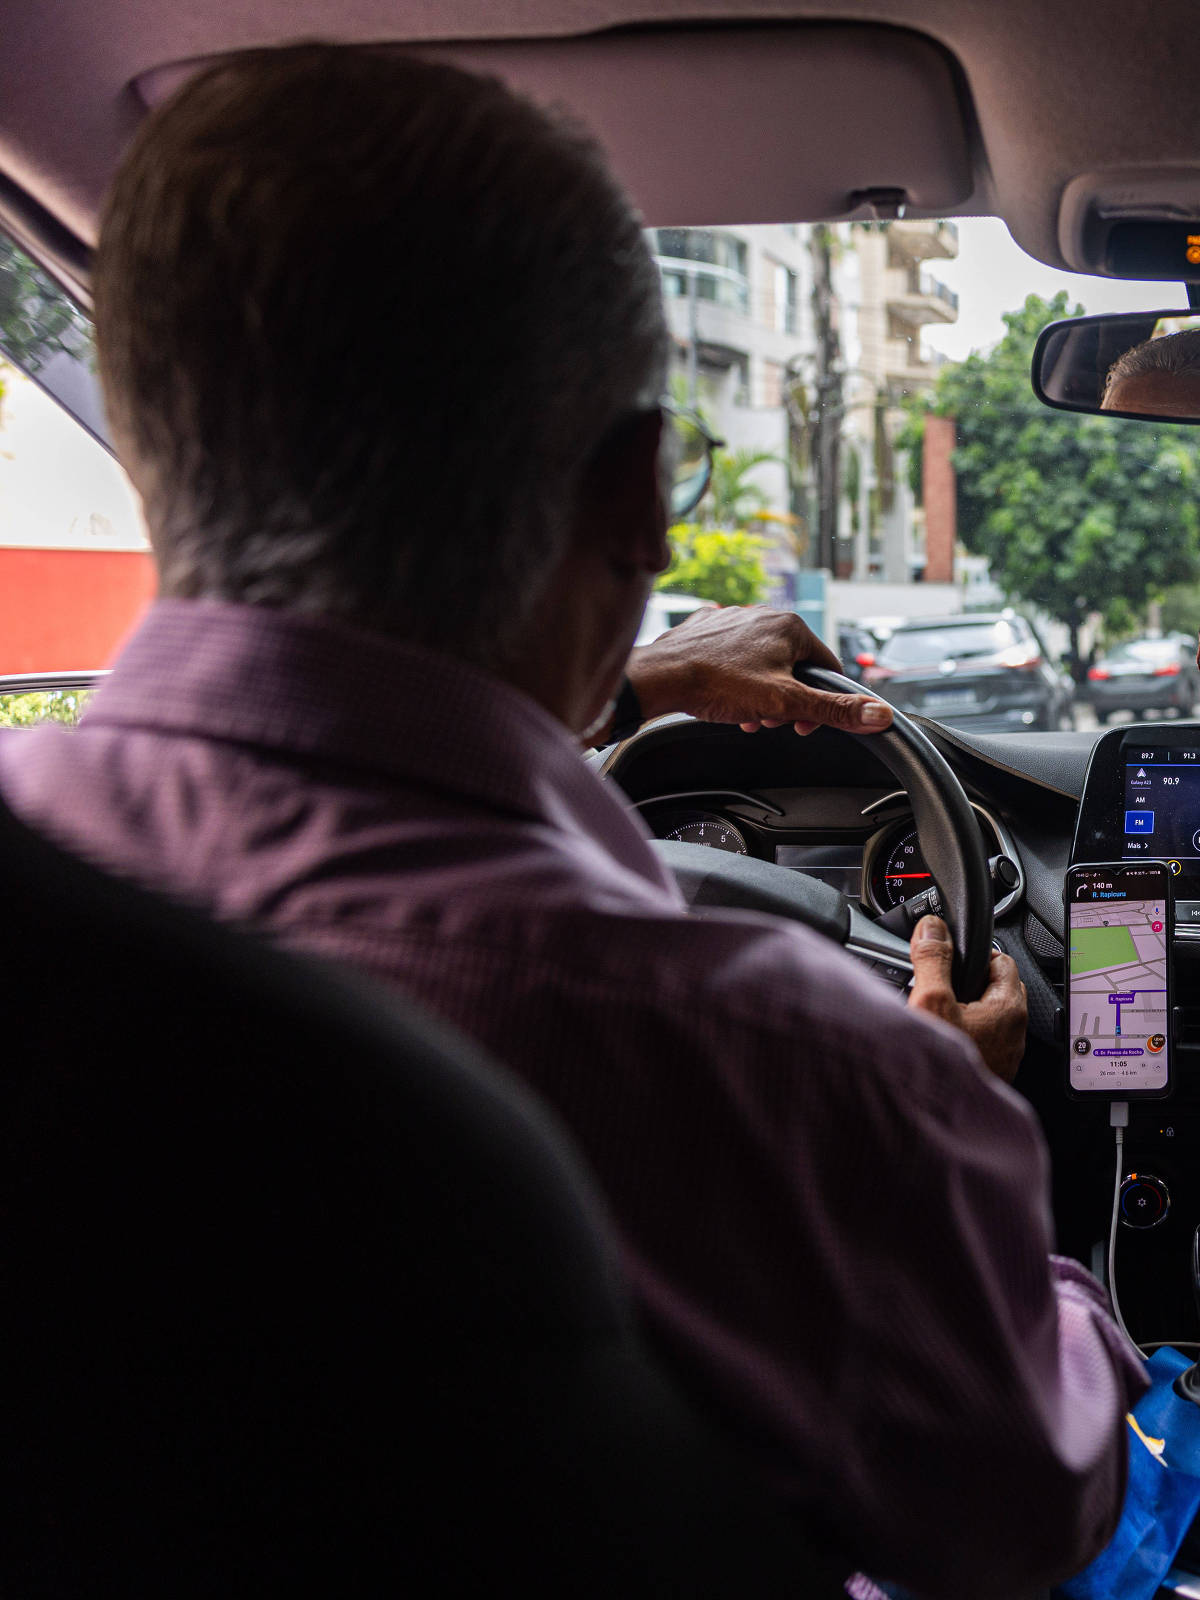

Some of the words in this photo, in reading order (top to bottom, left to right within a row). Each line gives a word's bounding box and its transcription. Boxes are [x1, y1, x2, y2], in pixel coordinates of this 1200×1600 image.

[1163, 777, 1180, 785] 90.9
[698, 828, 705, 837] 4
[720, 834, 726, 843] 5
[904, 845, 914, 854] 60
[894, 861, 905, 869] 40
[892, 878, 903, 887] 20
[899, 895, 905, 903] 0
